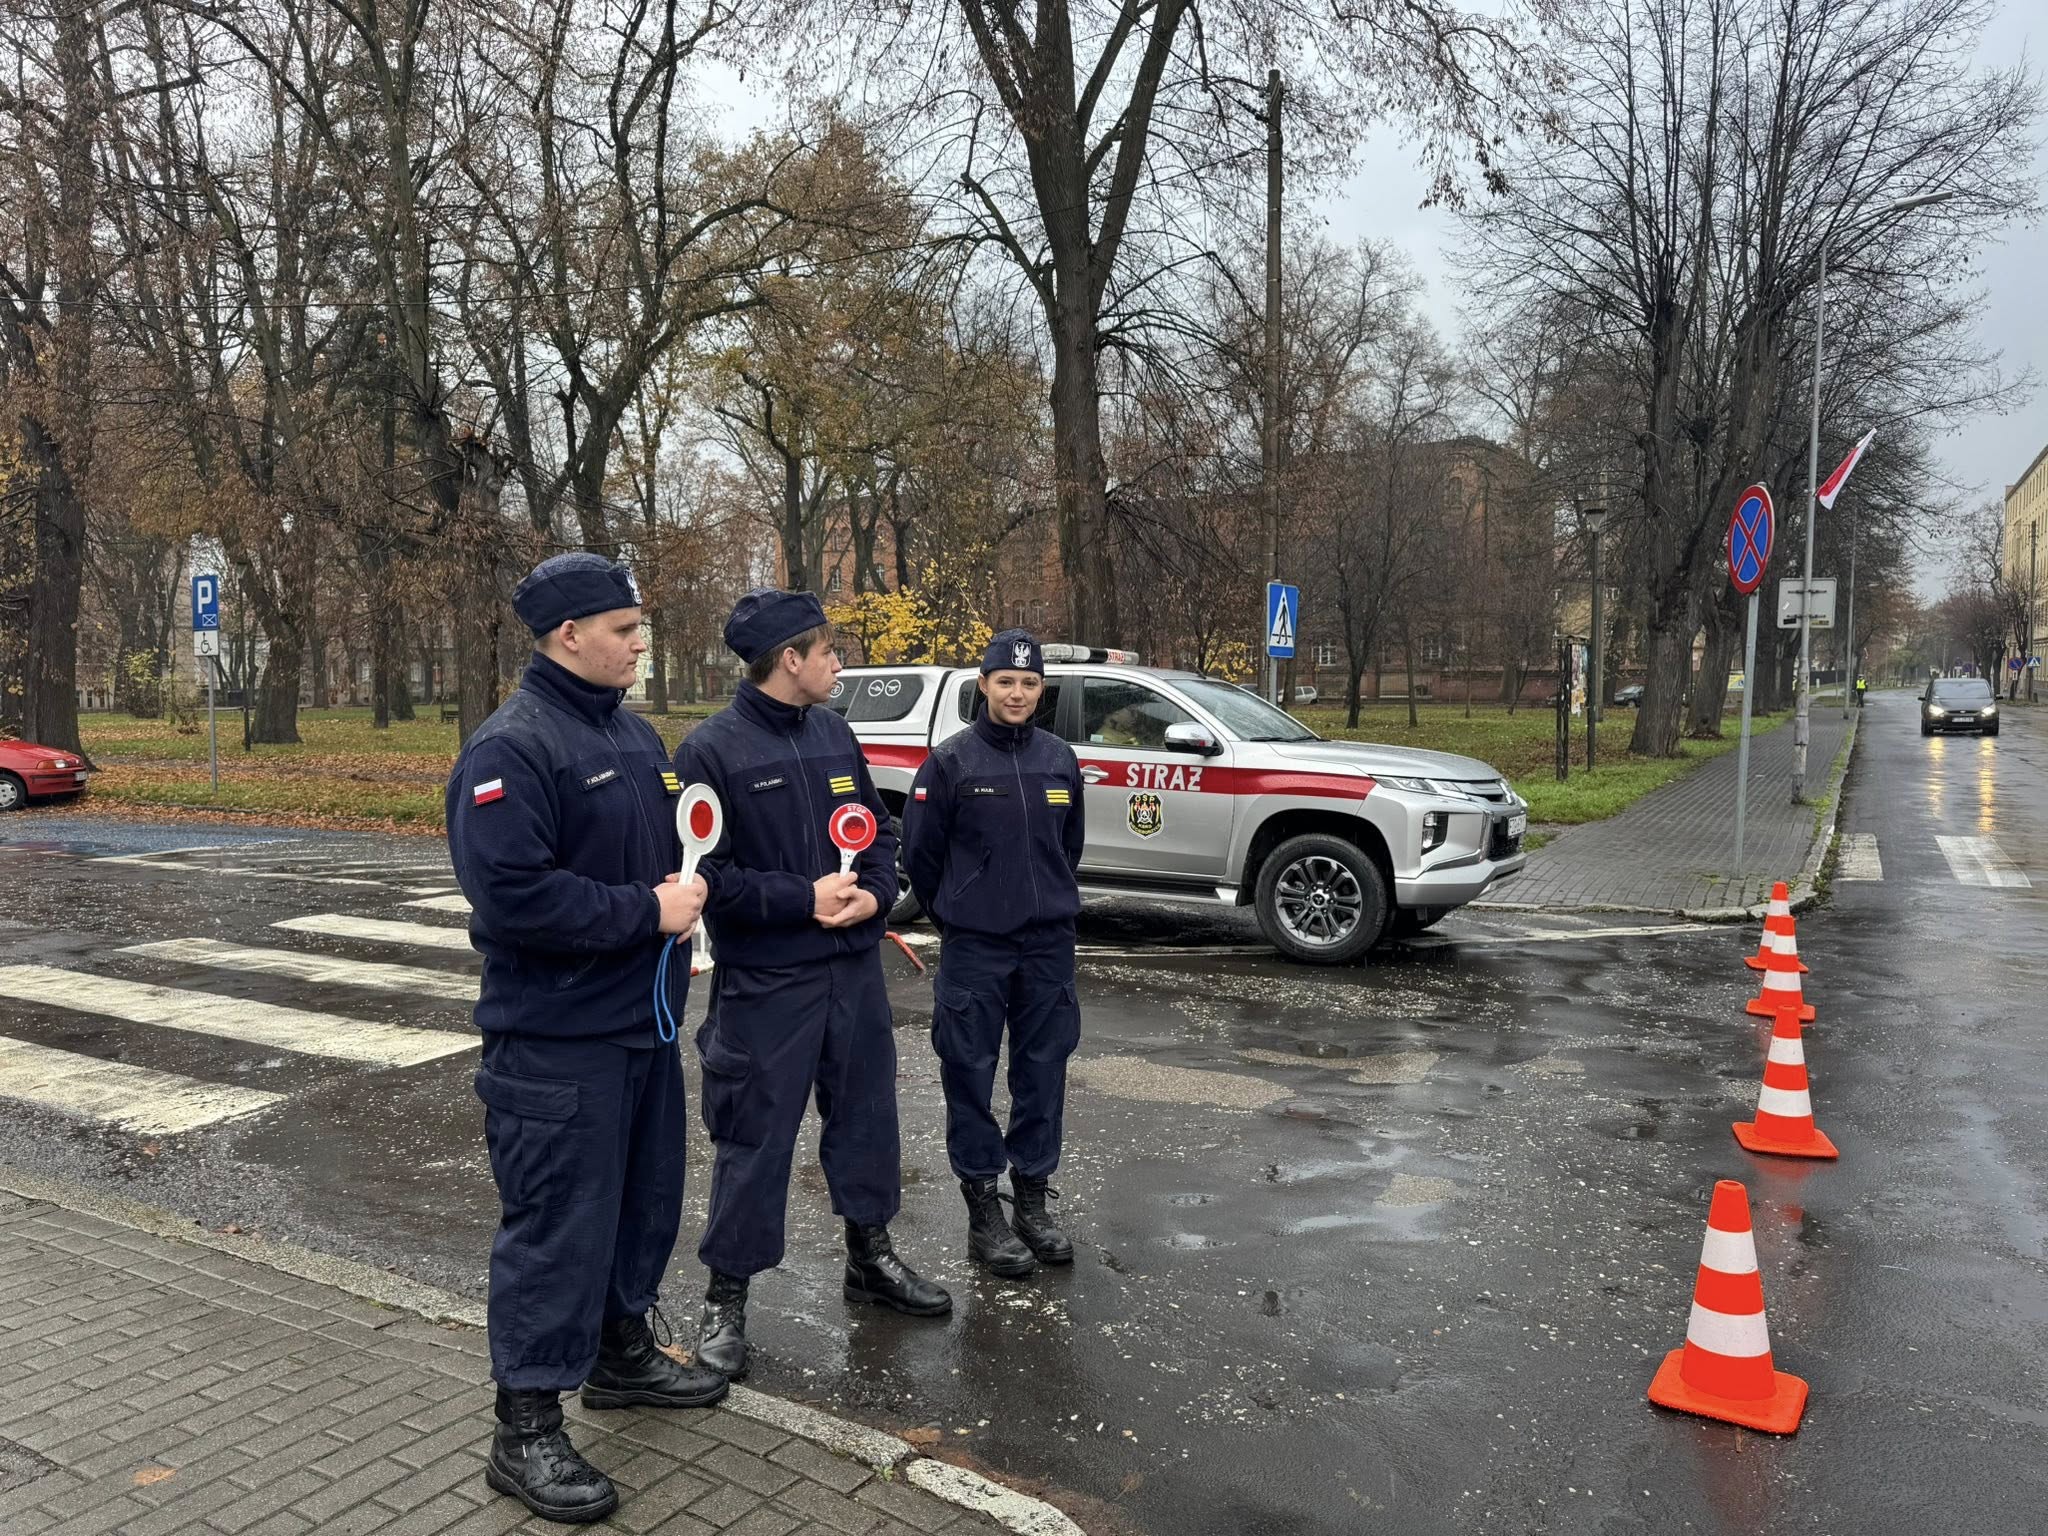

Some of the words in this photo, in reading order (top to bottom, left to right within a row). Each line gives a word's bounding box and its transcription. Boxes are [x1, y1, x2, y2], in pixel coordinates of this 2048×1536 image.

[197, 580, 212, 614] P
[1134, 794, 1156, 803] OSP
[847, 805, 867, 814] STOP
